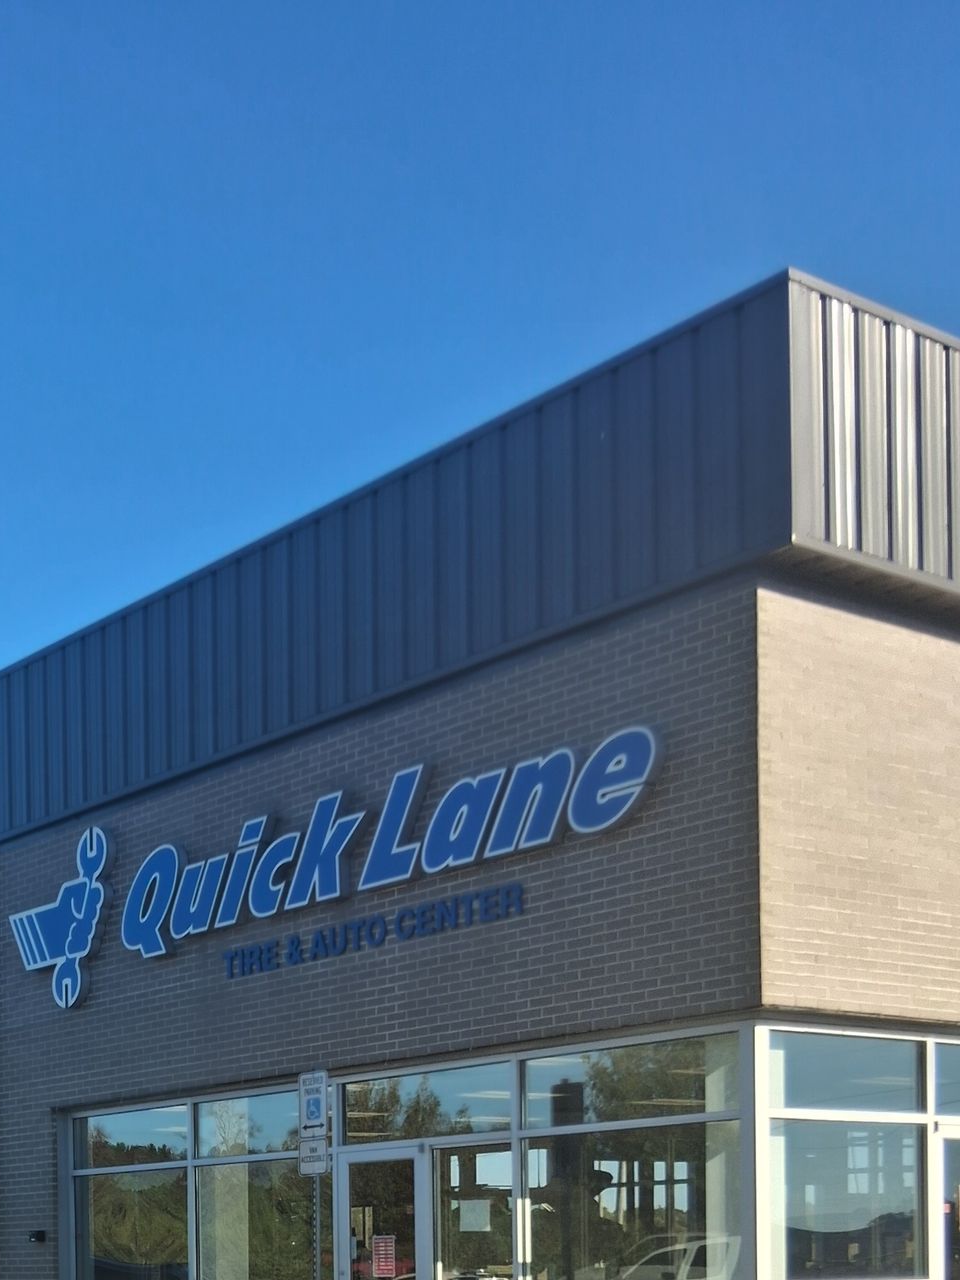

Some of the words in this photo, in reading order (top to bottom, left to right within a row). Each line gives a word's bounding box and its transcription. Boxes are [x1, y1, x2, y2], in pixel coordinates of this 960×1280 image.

[121, 791, 366, 958] Quick
[357, 725, 657, 891] Lane
[222, 939, 279, 979] TIRE
[287, 933, 303, 965] &
[310, 914, 388, 960] AUTO
[395, 884, 525, 941] CENTER
